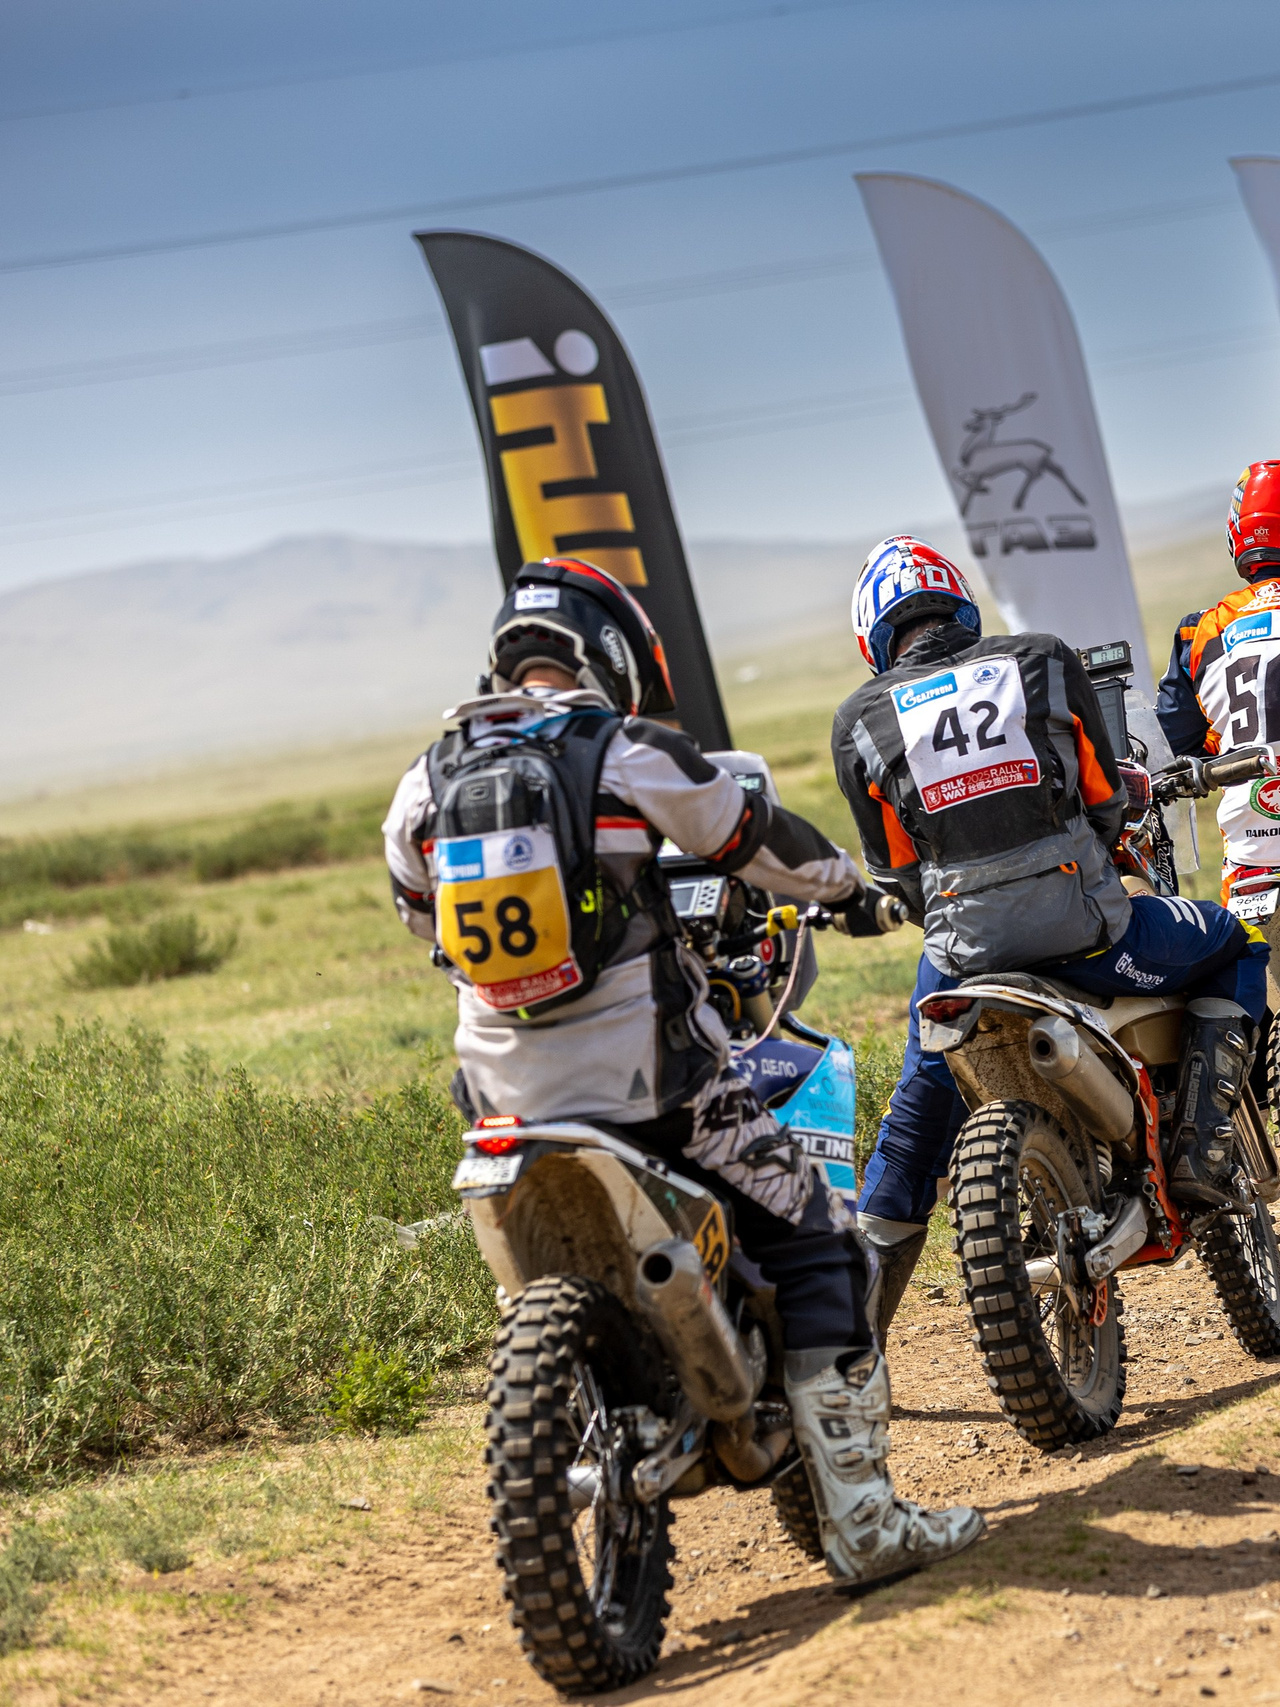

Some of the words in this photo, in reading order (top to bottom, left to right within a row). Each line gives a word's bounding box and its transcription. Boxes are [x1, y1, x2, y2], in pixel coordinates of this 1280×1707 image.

[967, 514, 1096, 558] ГАЗ
[915, 683, 954, 704] GAZPROM
[932, 700, 1007, 757] 42
[940, 778, 965, 793] SILK
[965, 770, 991, 785] 2025
[990, 764, 1021, 778] RALLY
[942, 788, 967, 801] WAY
[455, 895, 538, 964] 58
[761, 1058, 798, 1078] ДЕЛО
